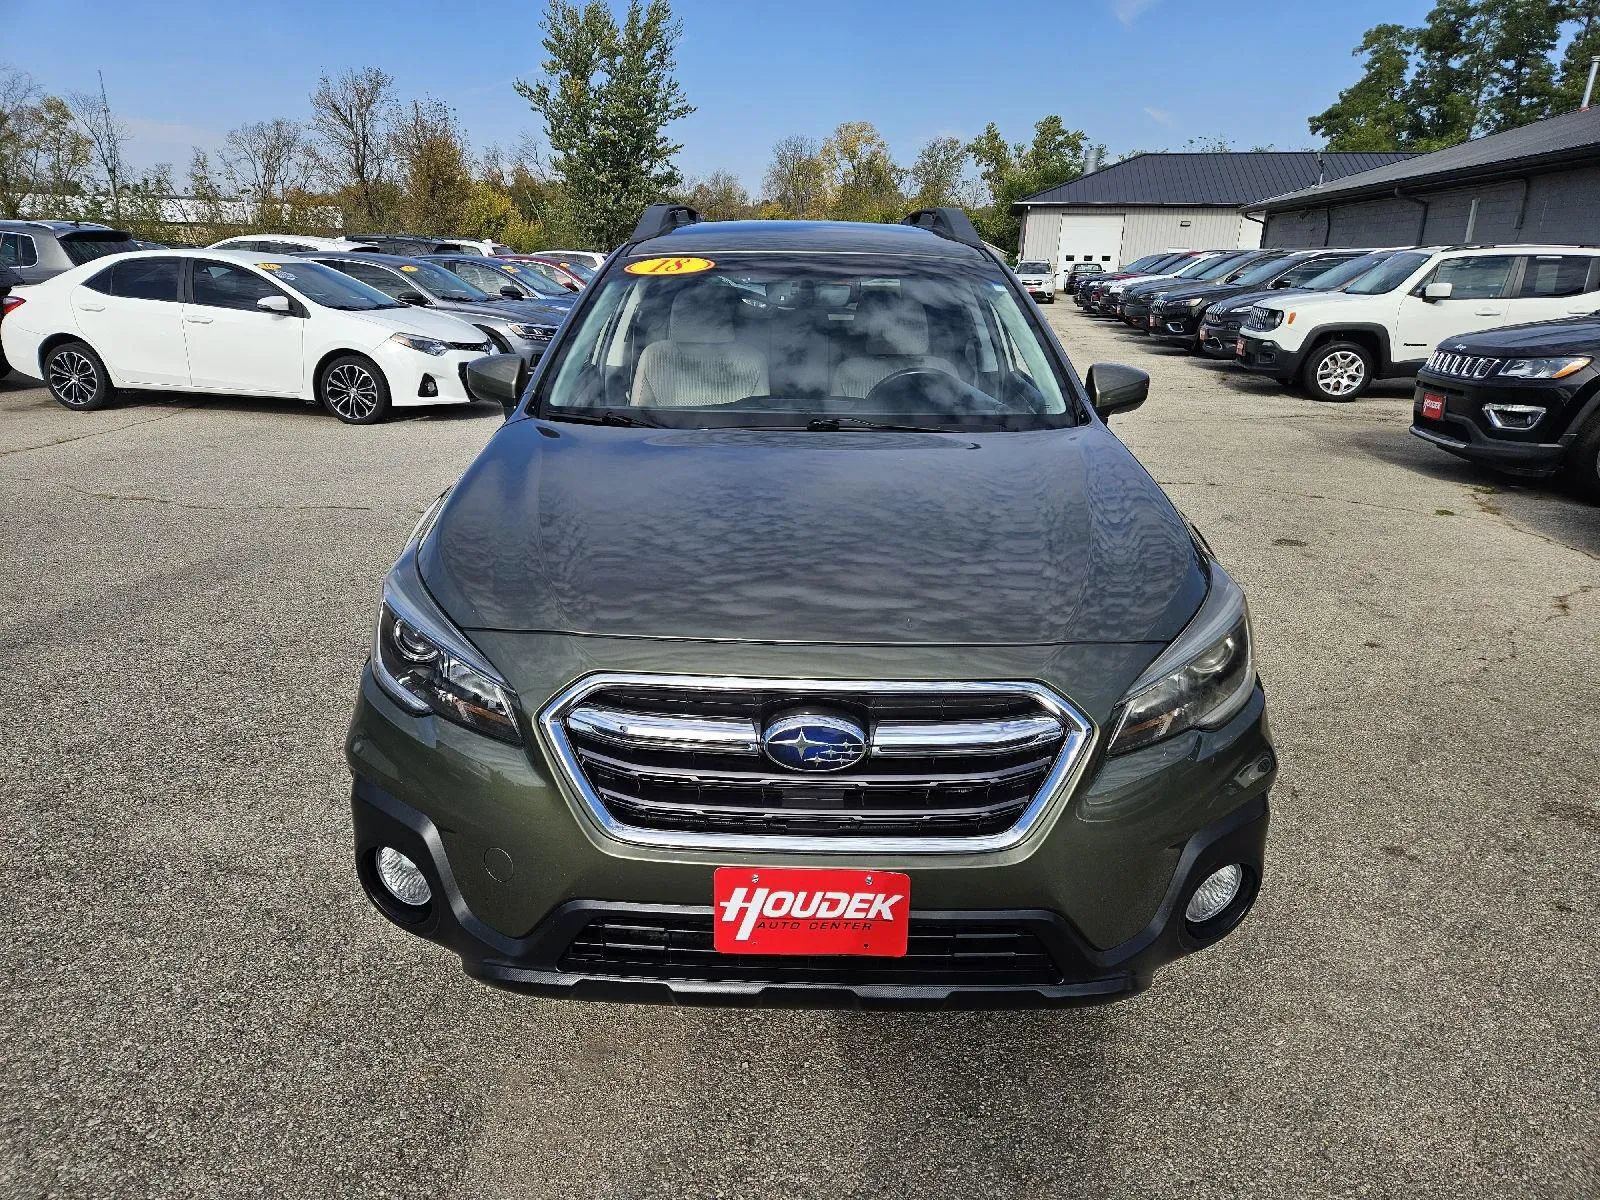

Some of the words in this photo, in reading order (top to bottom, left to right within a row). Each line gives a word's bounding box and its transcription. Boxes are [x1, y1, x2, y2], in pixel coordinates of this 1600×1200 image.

[649, 258, 691, 272] 18
[719, 887, 905, 941] HOUDEK
[756, 921, 801, 930] AUTO
[808, 921, 873, 931] CENTER
